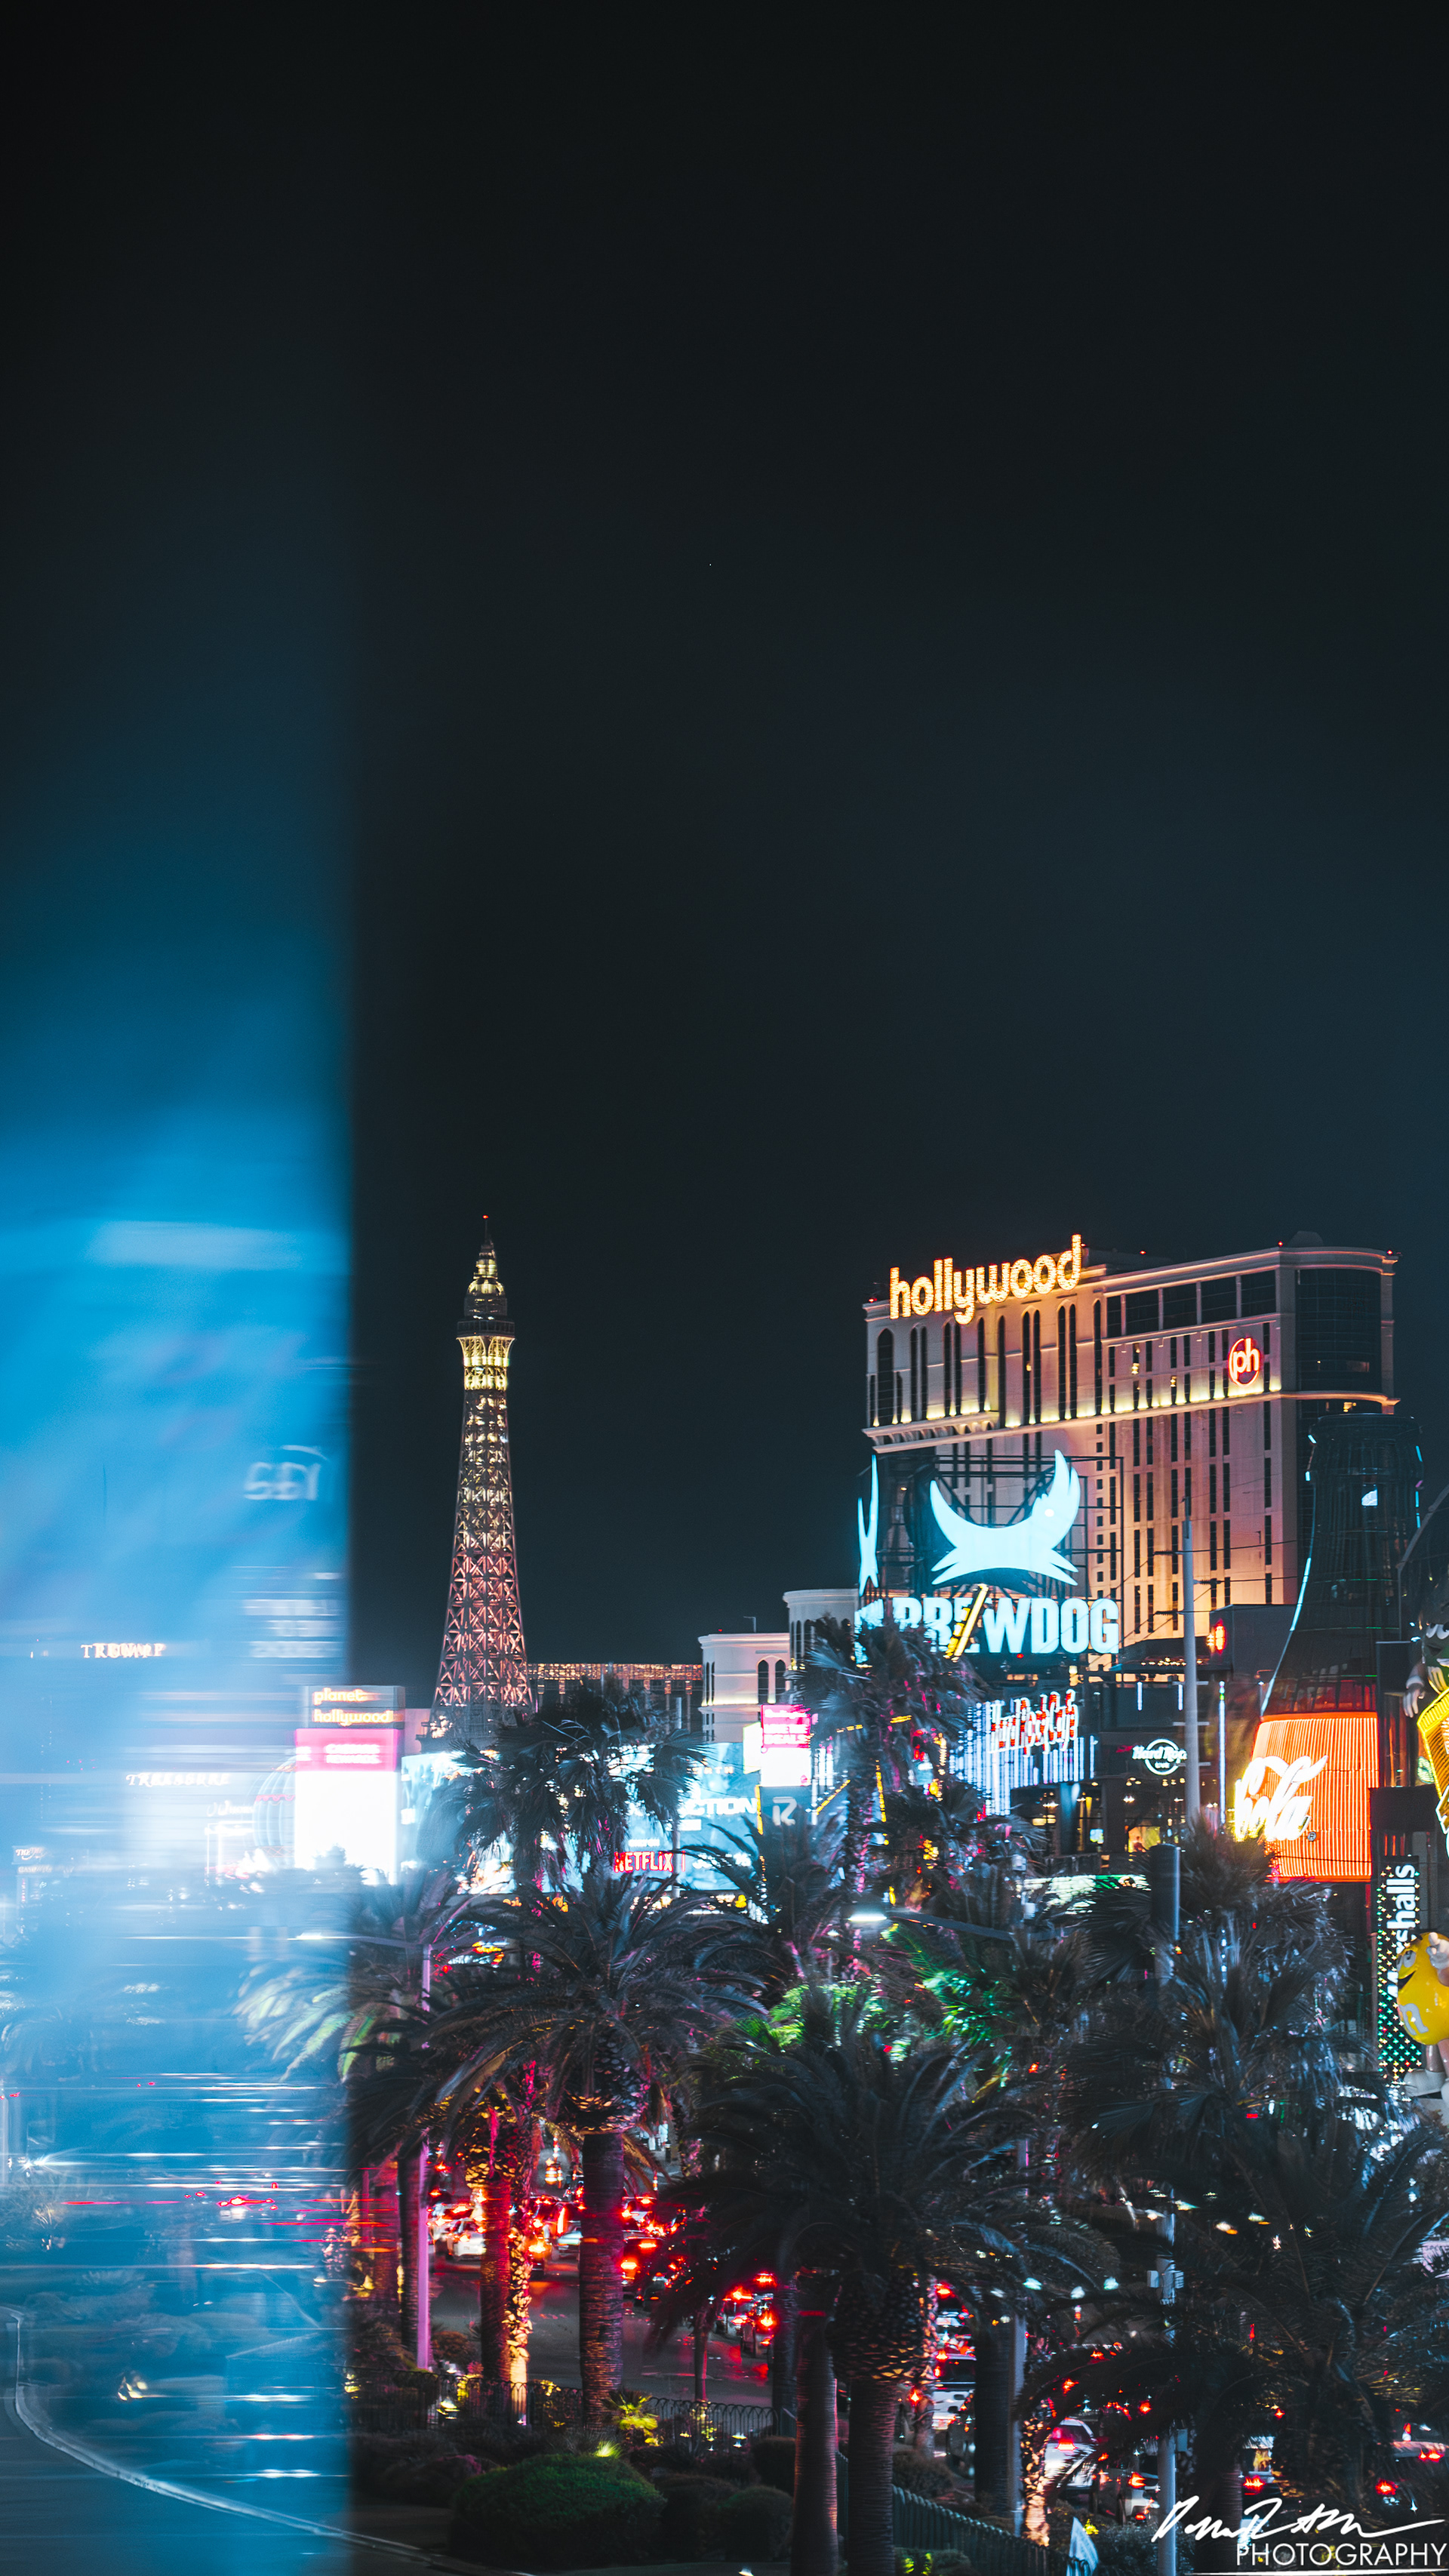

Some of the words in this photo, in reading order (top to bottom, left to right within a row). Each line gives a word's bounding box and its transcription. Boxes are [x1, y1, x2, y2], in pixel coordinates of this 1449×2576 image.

[890, 1233, 1081, 1325] hollywood
[1232, 1337, 1260, 1381] ph
[313, 1688, 365, 1706] planet
[313, 1709, 395, 1727] hollywood
[614, 1851, 674, 1873] NETFLIX
